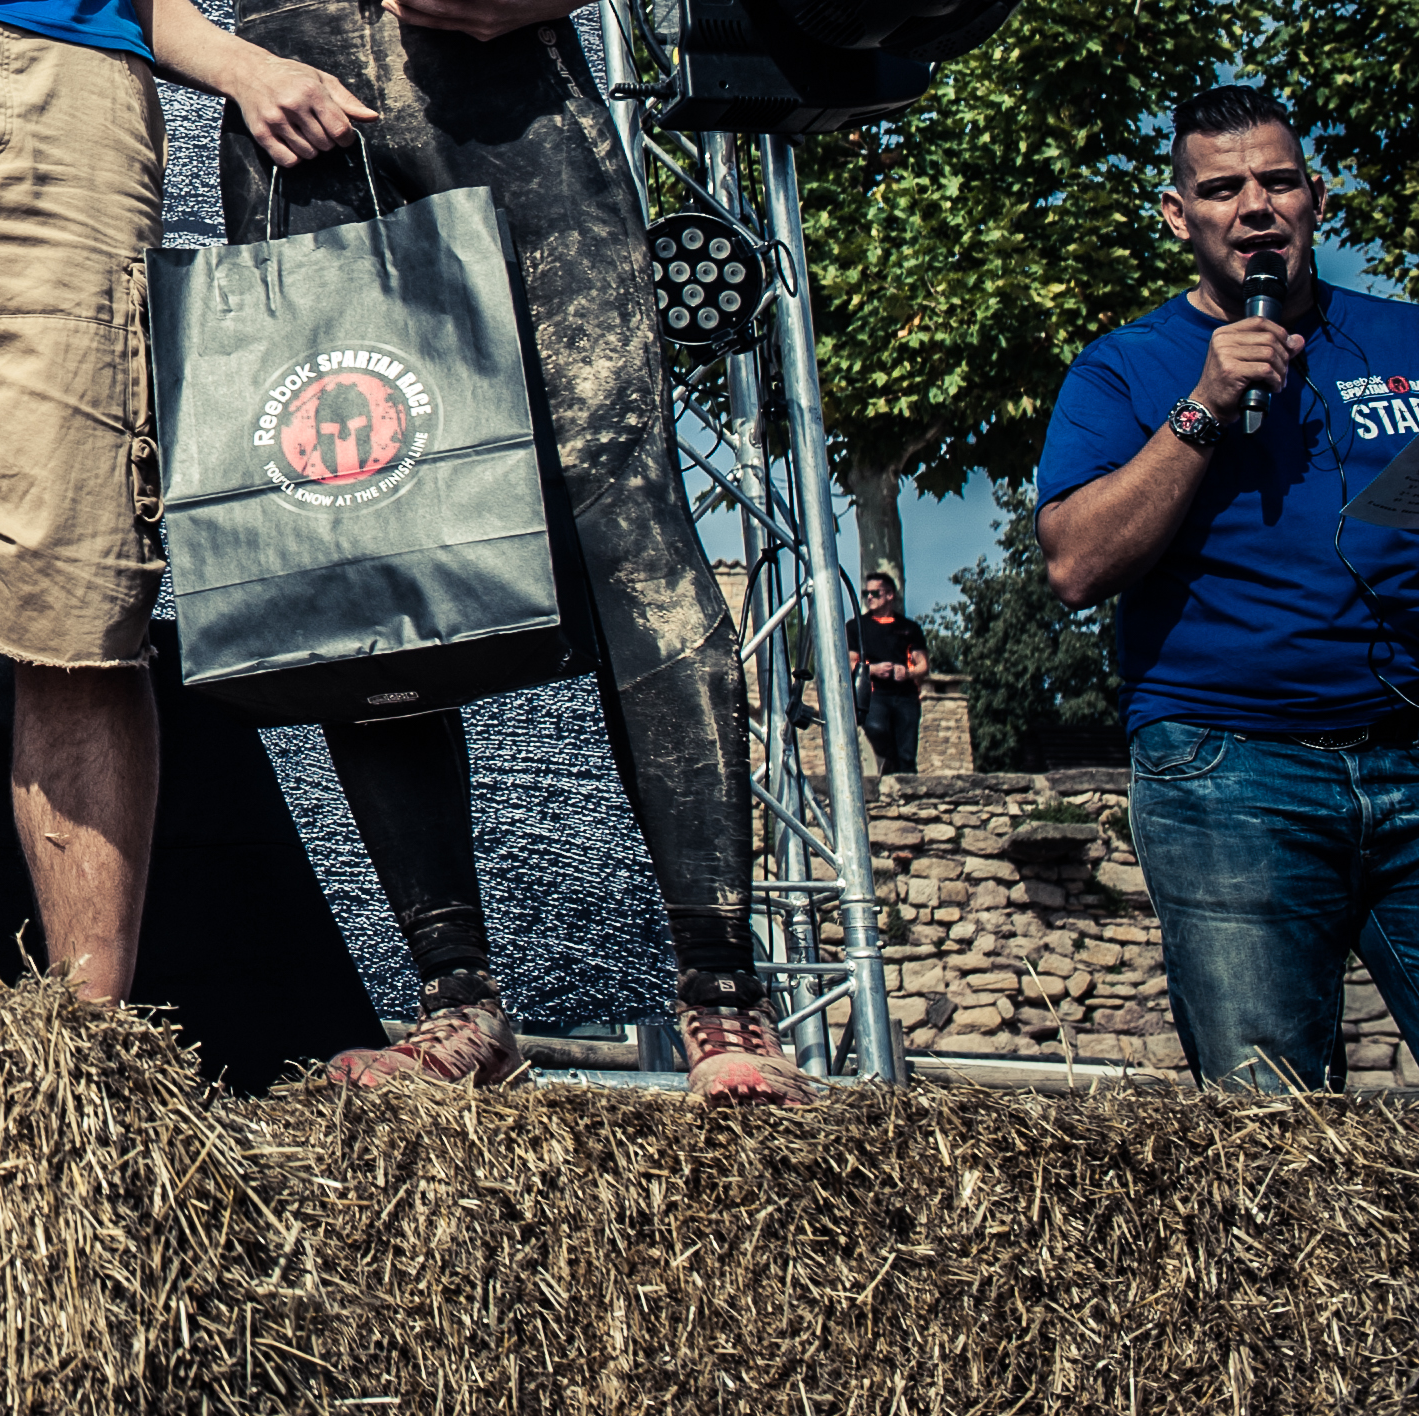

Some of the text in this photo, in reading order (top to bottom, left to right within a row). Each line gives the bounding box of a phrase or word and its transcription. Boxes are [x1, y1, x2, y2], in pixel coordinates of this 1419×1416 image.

[253, 350, 431, 446] Reebok SPARTAN RACE
[263, 431, 428, 507] YOU'LL KNOW AT THE FINISH LINE
